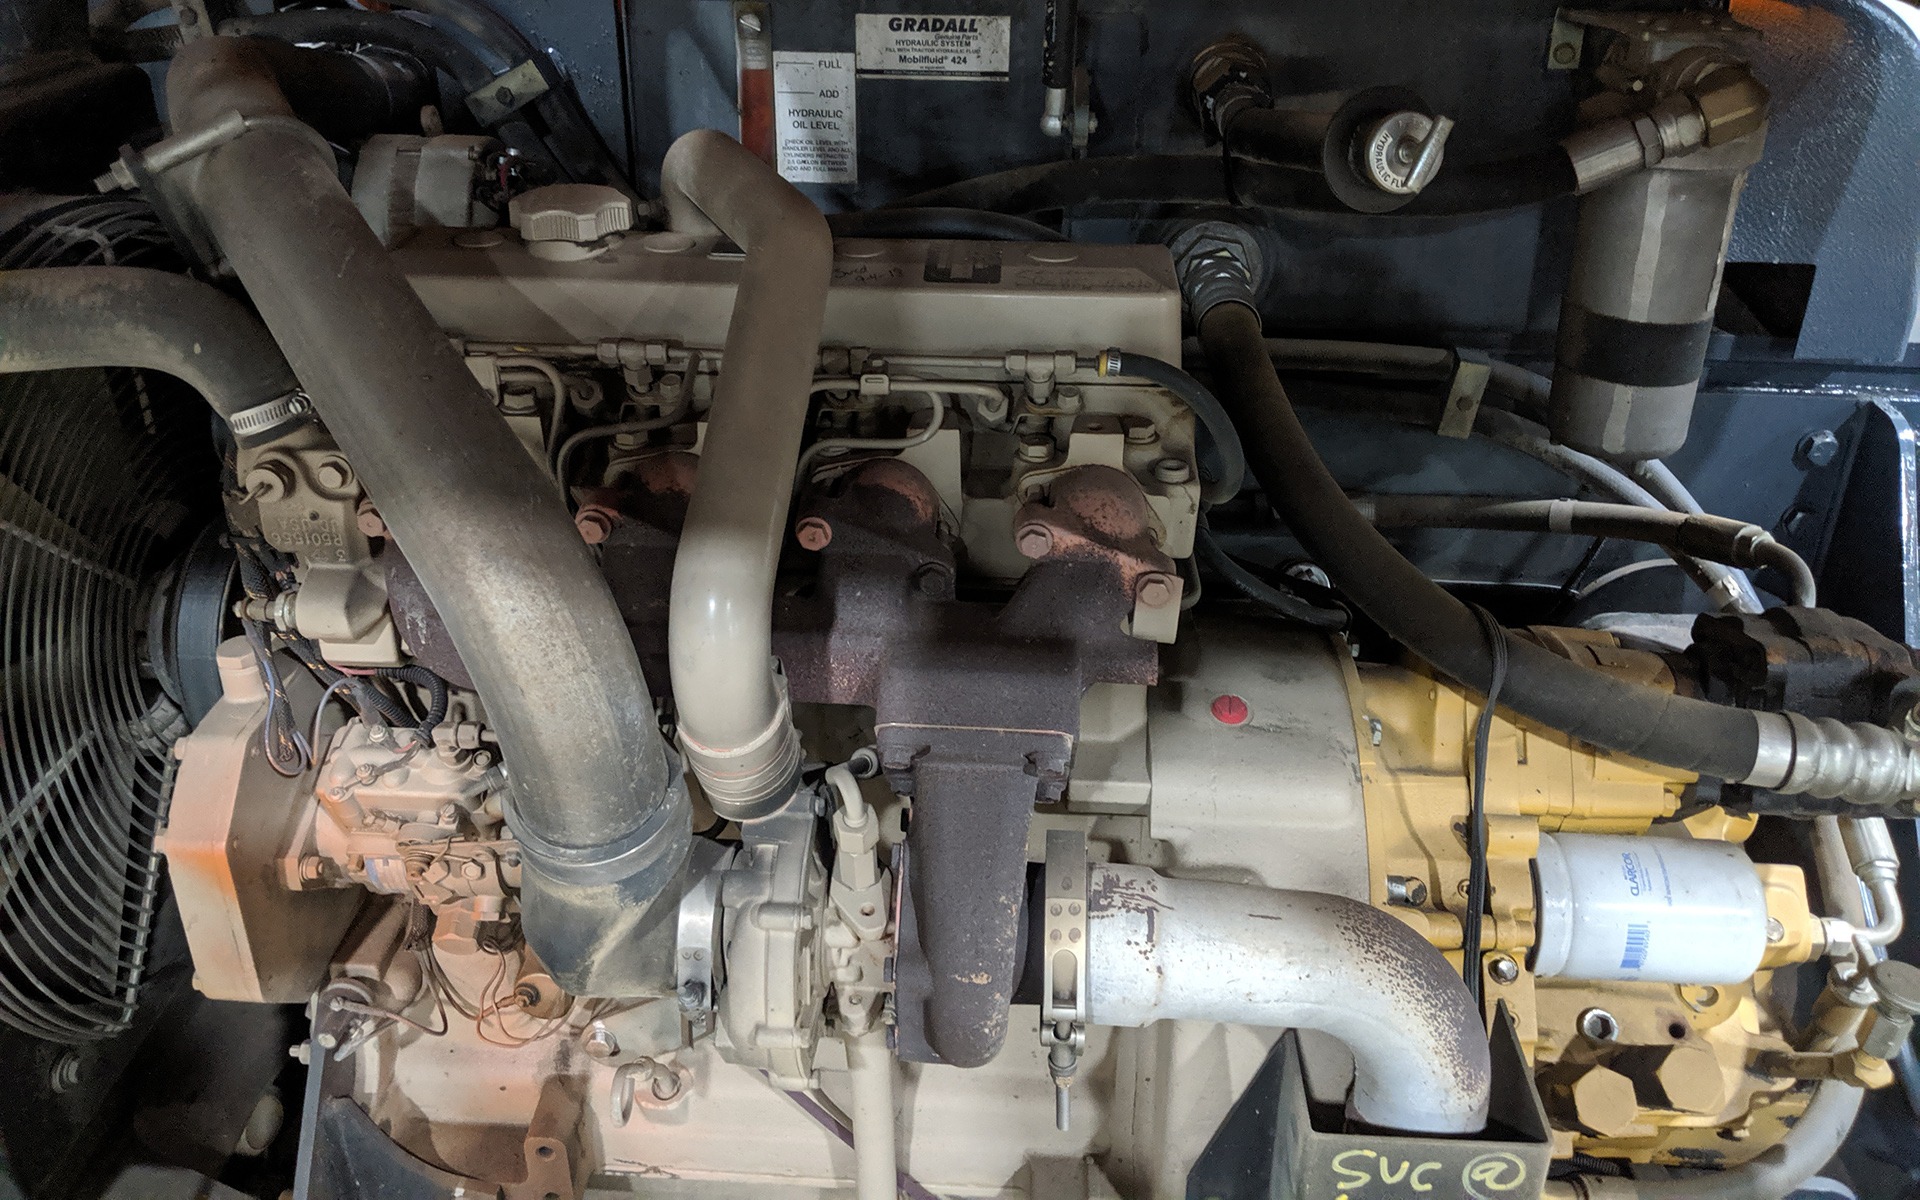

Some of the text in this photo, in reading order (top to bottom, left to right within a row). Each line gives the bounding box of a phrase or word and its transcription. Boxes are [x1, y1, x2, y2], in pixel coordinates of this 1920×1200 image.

[888, 17, 978, 33] GRADALL
[961, 33, 979, 41] Parts
[895, 39, 939, 47] HYDRAULIC
[818, 59, 842, 69] FULL
[950, 56, 968, 65] 424
[818, 89, 840, 99] ADD
[788, 108, 844, 119] HYDRAULIC
[792, 120, 840, 130] OIL LEVEL
[1375, 133, 1391, 182] HYDRAULIC
[1621, 852, 1640, 896] CLARCOR
